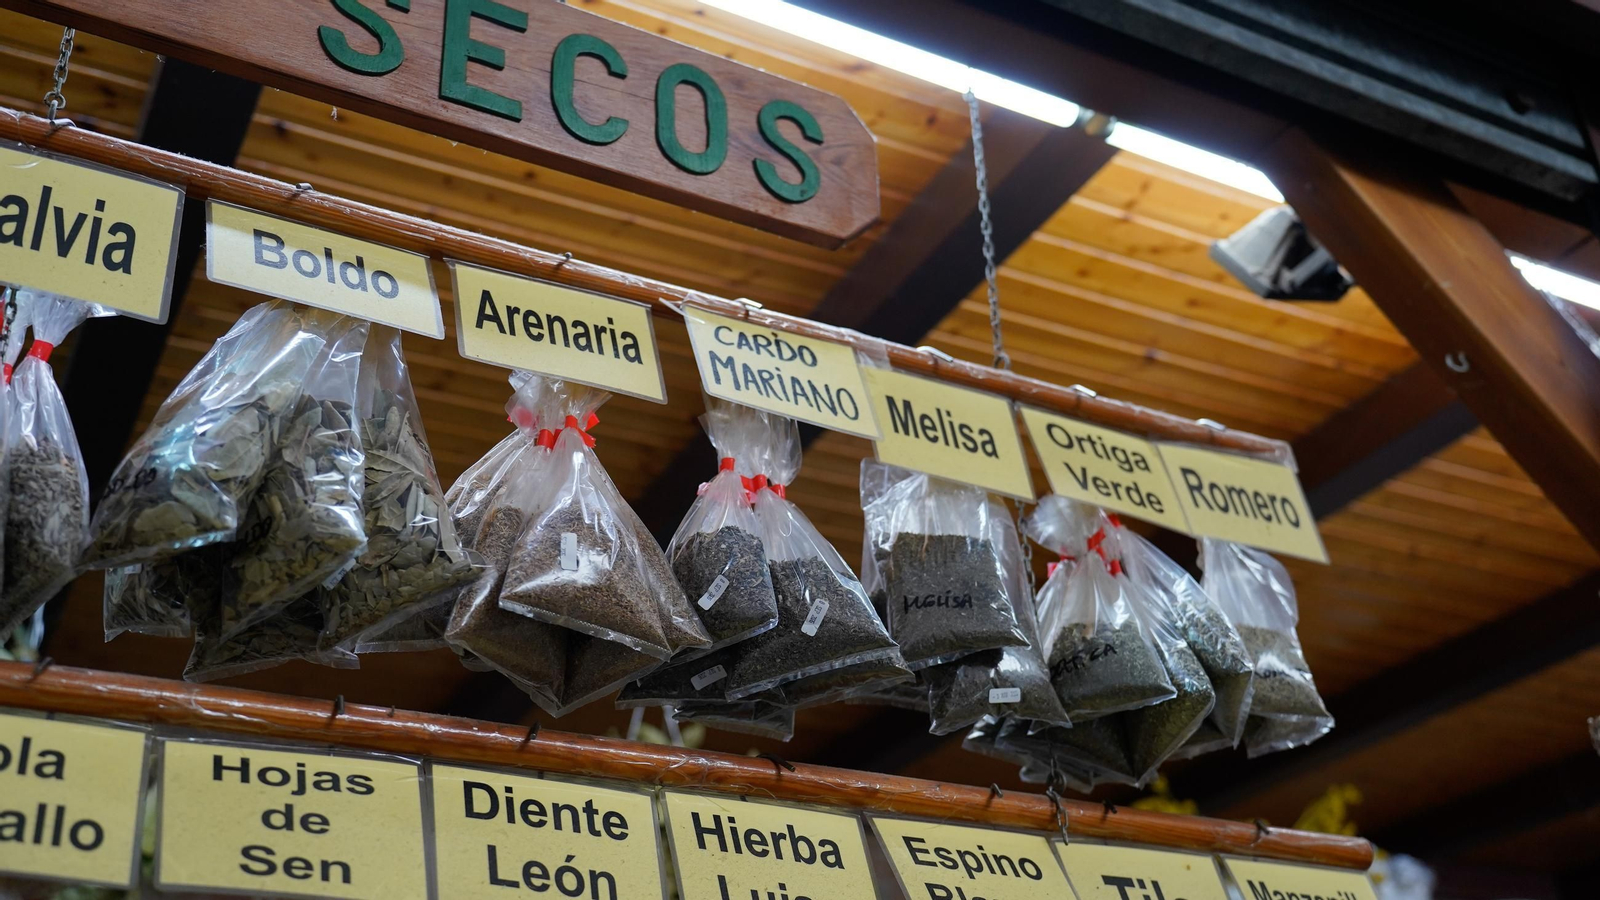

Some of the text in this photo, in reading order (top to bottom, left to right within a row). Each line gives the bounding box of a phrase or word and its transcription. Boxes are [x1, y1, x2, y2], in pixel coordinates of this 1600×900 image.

[317, 0, 824, 204] SECOS
[252, 228, 400, 299] Boldo
[475, 288, 644, 365] Arenaria
[714, 325, 818, 368] CARDO
[885, 395, 1000, 459] Melisa
[1046, 423, 1151, 474] Ortiga
[1063, 461, 1165, 514] Verde
[1180, 467, 1300, 529] Romero
[212, 754, 376, 796] Hojas
[260, 803, 332, 834] de
[463, 780, 629, 841] Diente
[239, 844, 352, 884] Sen
[690, 811, 845, 870] Hierba
[901, 835, 1043, 881] Espino
[487, 844, 618, 900] León
